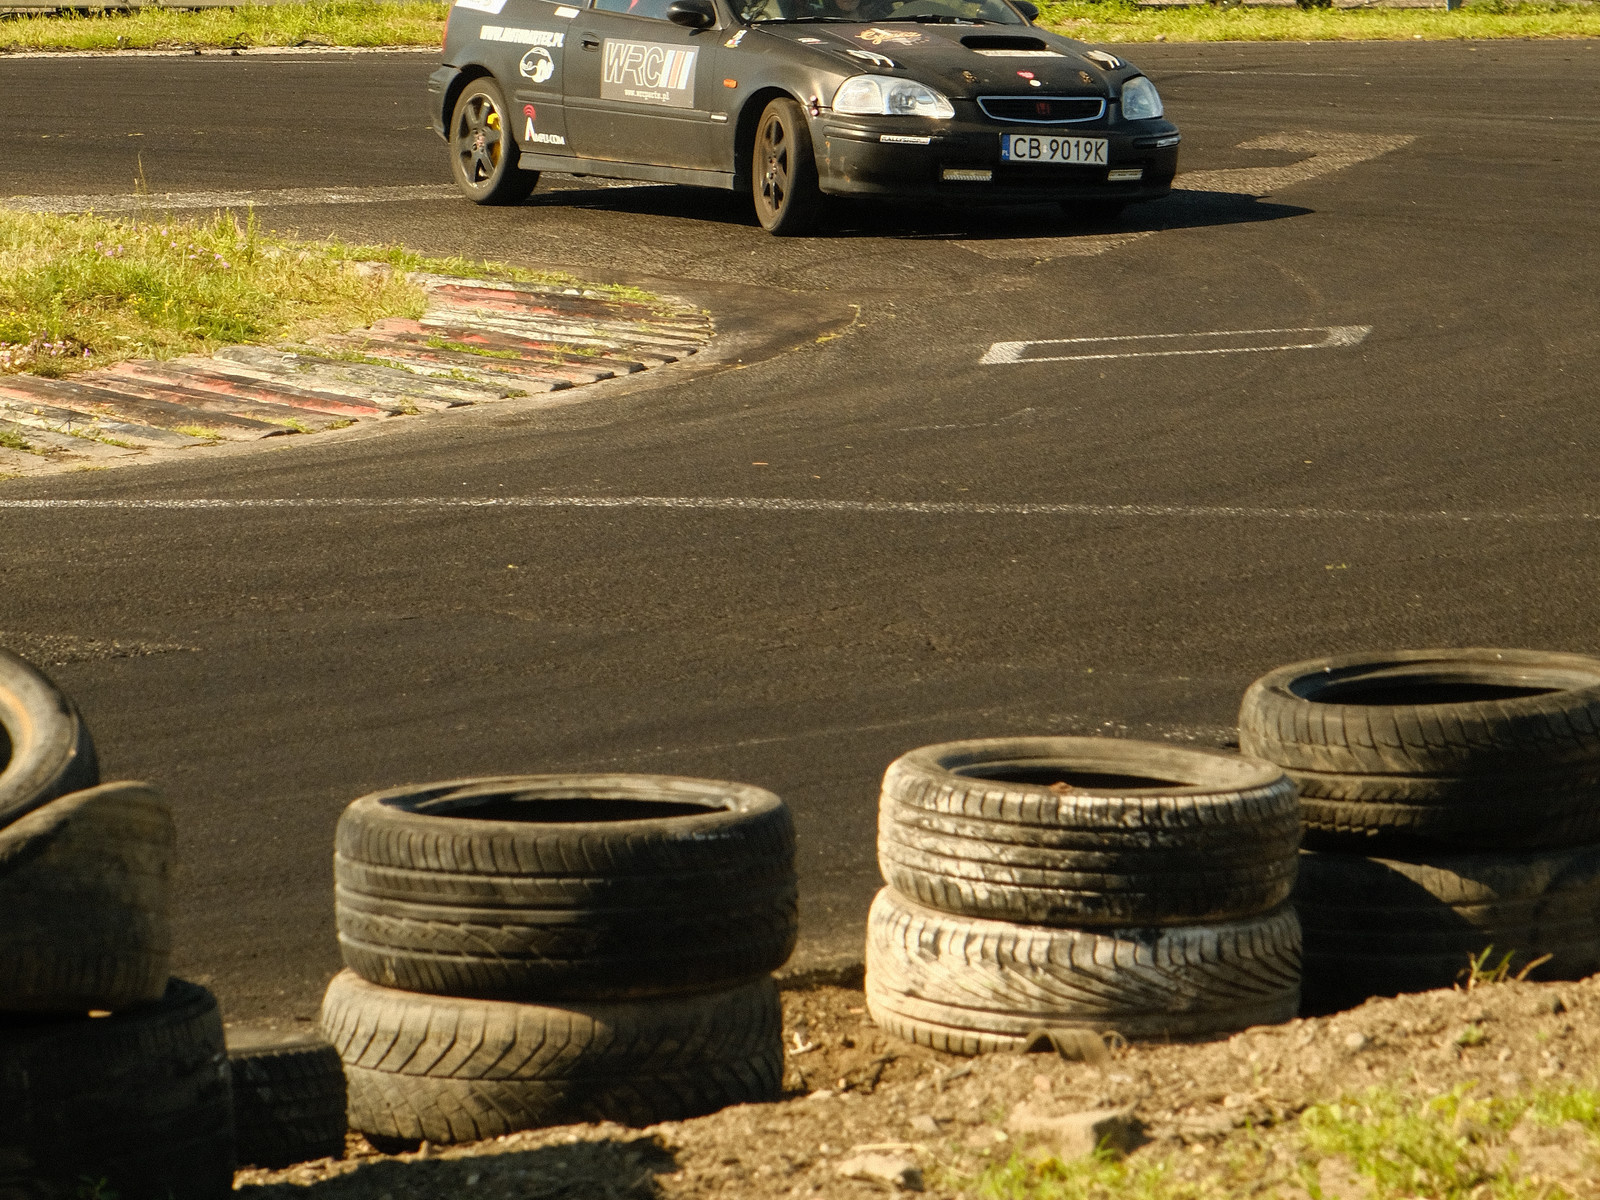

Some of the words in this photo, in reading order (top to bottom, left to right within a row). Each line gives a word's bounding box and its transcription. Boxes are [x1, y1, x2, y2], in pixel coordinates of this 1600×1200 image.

[603, 42, 664, 88] WRC
[1014, 137, 1041, 159] CB
[1049, 138, 1105, 162] 9019K
